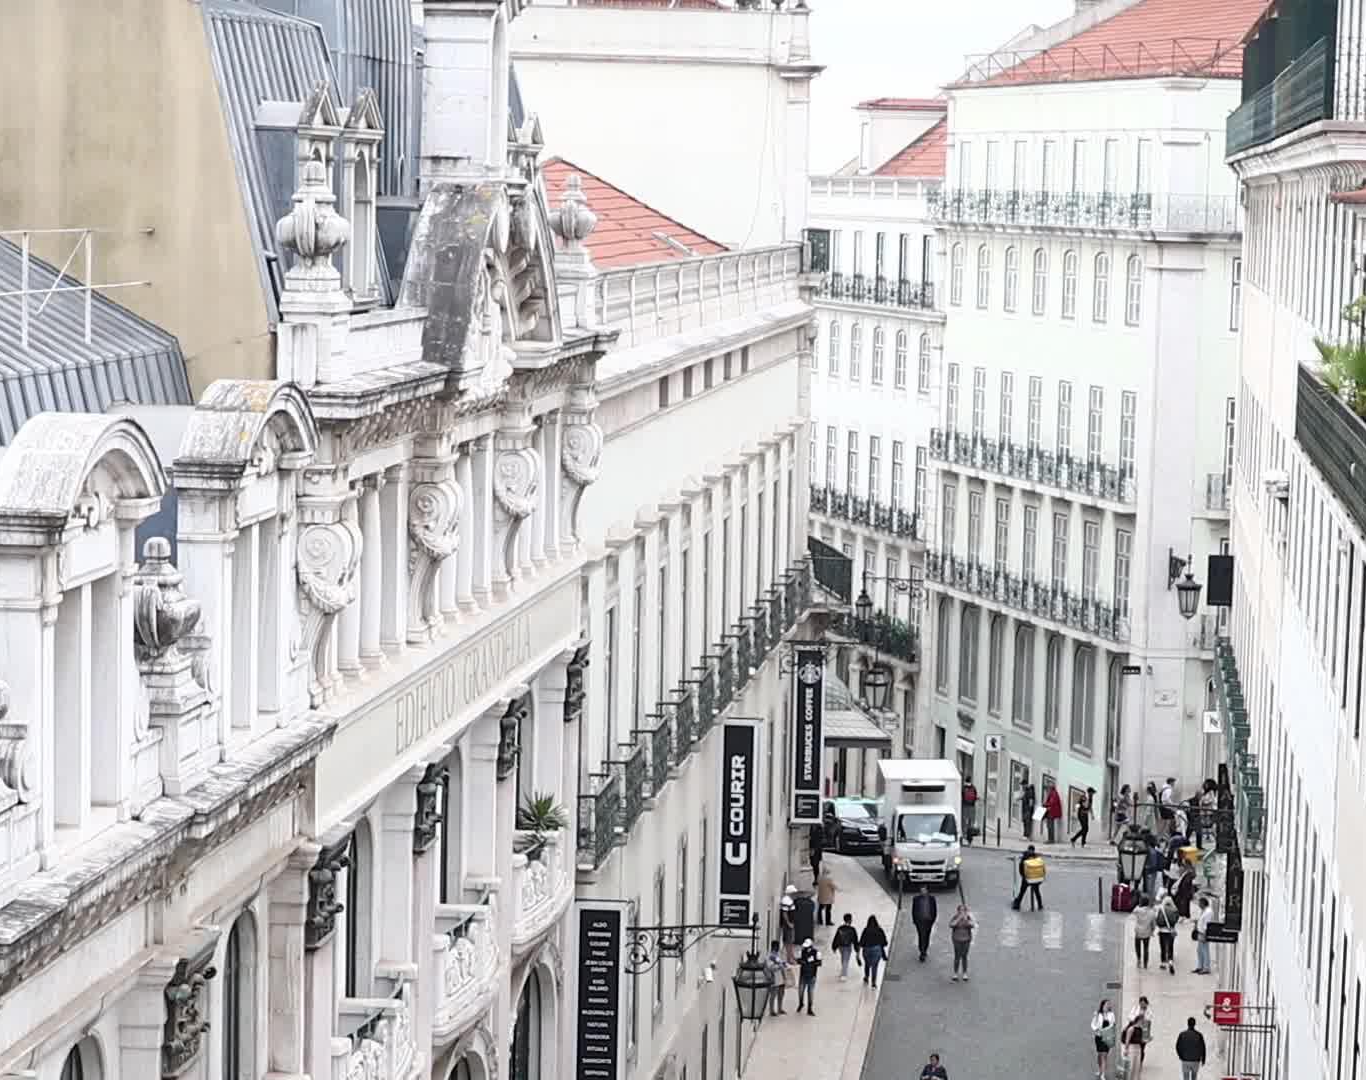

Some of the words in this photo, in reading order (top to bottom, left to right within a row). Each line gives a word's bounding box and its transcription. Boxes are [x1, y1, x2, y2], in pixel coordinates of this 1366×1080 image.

[804, 687, 814, 721] COFFEE
[803, 724, 814, 781] STARBUCKS
[729, 754, 747, 837] COURIR
